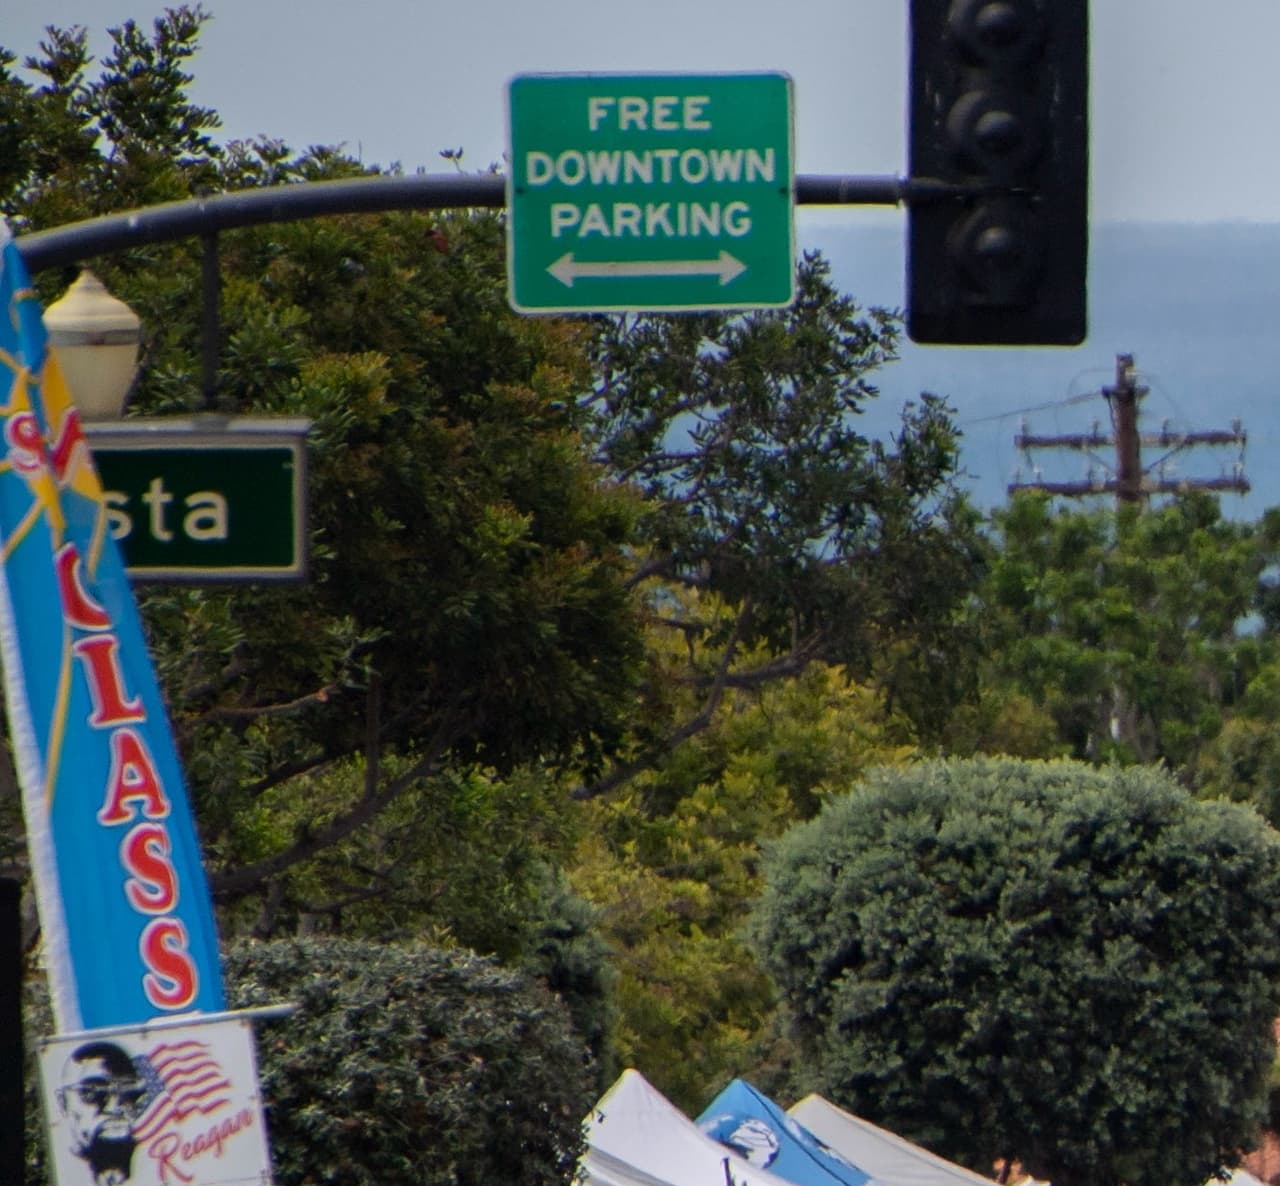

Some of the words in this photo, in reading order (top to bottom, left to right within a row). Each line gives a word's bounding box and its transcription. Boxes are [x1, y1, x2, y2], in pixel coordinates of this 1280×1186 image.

[588, 96, 711, 131] FREE
[526, 148, 775, 185] DOWNTOWN
[550, 202, 751, 237] PARKING
[104, 477, 229, 542] sta
[148, 1108, 254, 1183] Reagan
